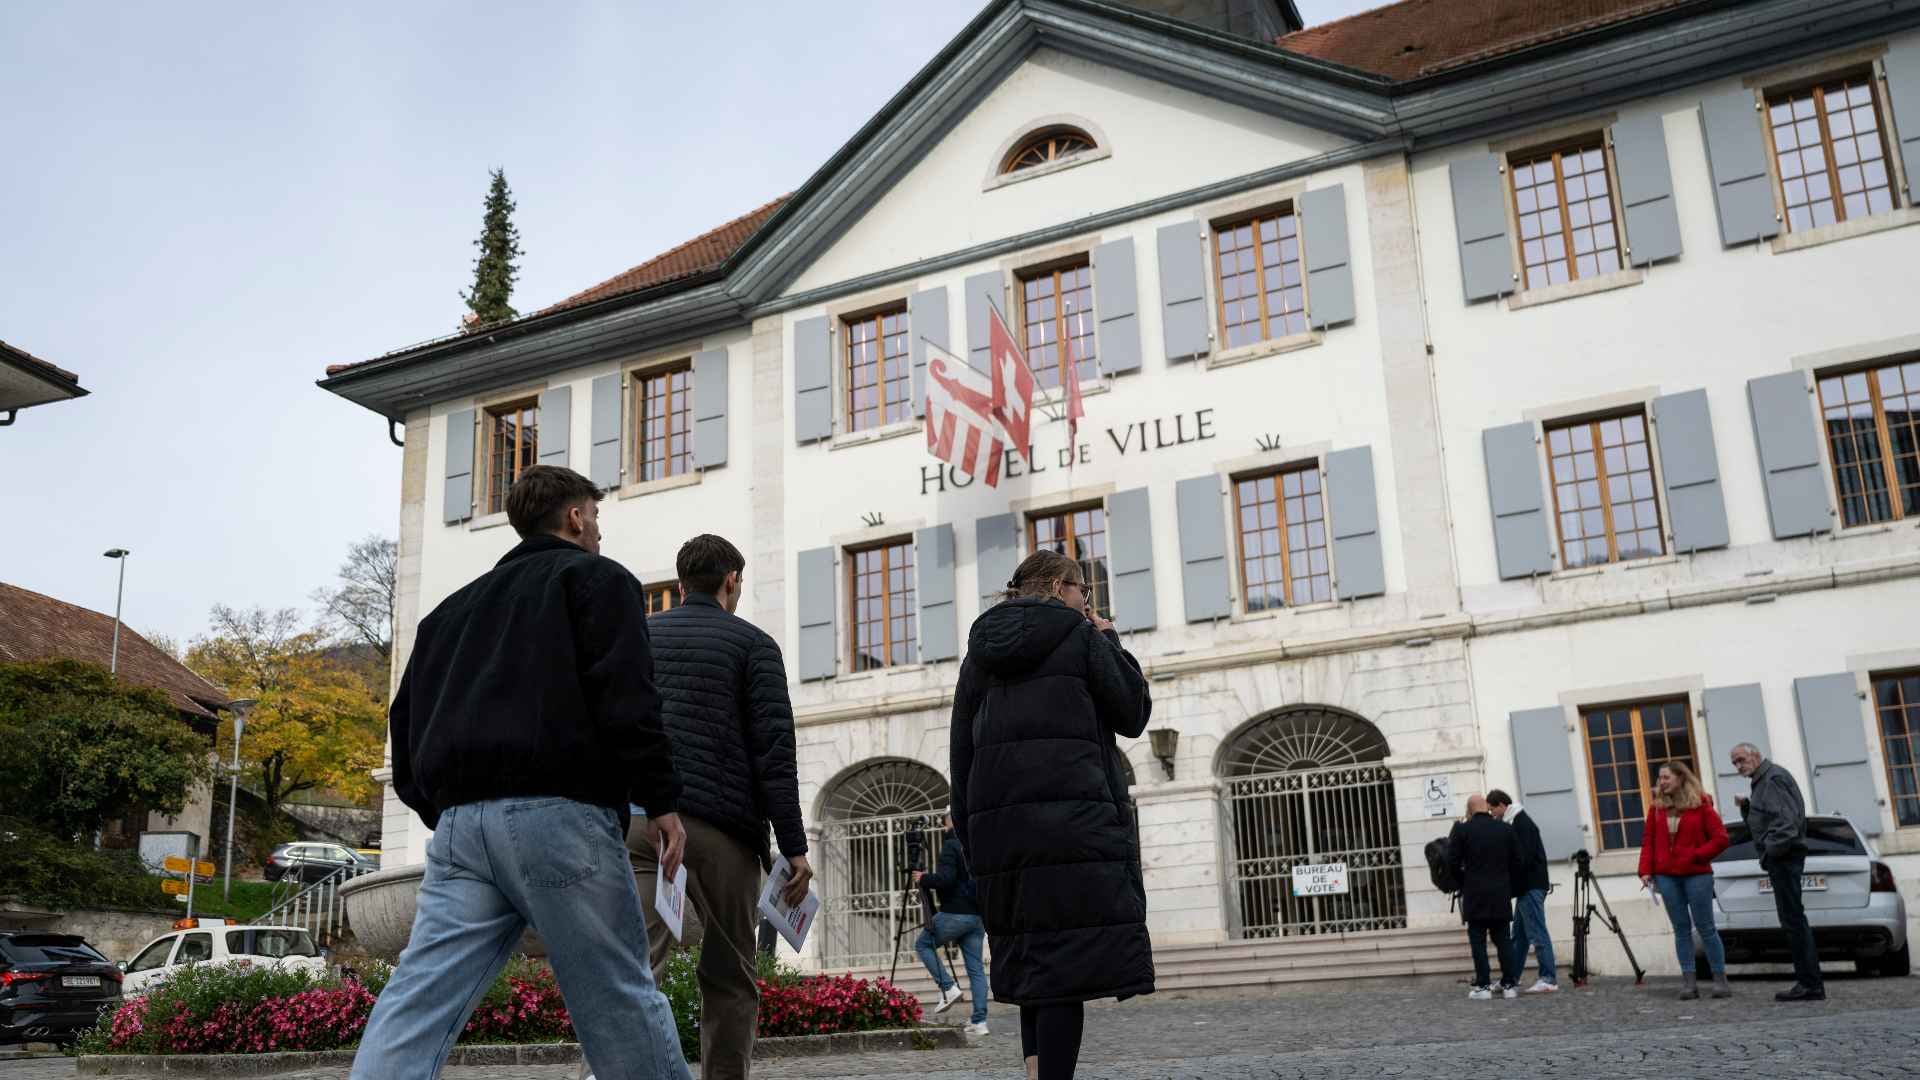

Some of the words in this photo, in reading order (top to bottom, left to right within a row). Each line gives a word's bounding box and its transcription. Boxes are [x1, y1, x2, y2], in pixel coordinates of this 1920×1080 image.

[920, 445, 1046, 494] HOEL
[1058, 444, 1092, 468] DE
[1107, 408, 1217, 455] VILLE
[1296, 864, 1343, 875] BUREAU
[1312, 875, 1328, 884] DE
[1305, 884, 1336, 893] VOTE
